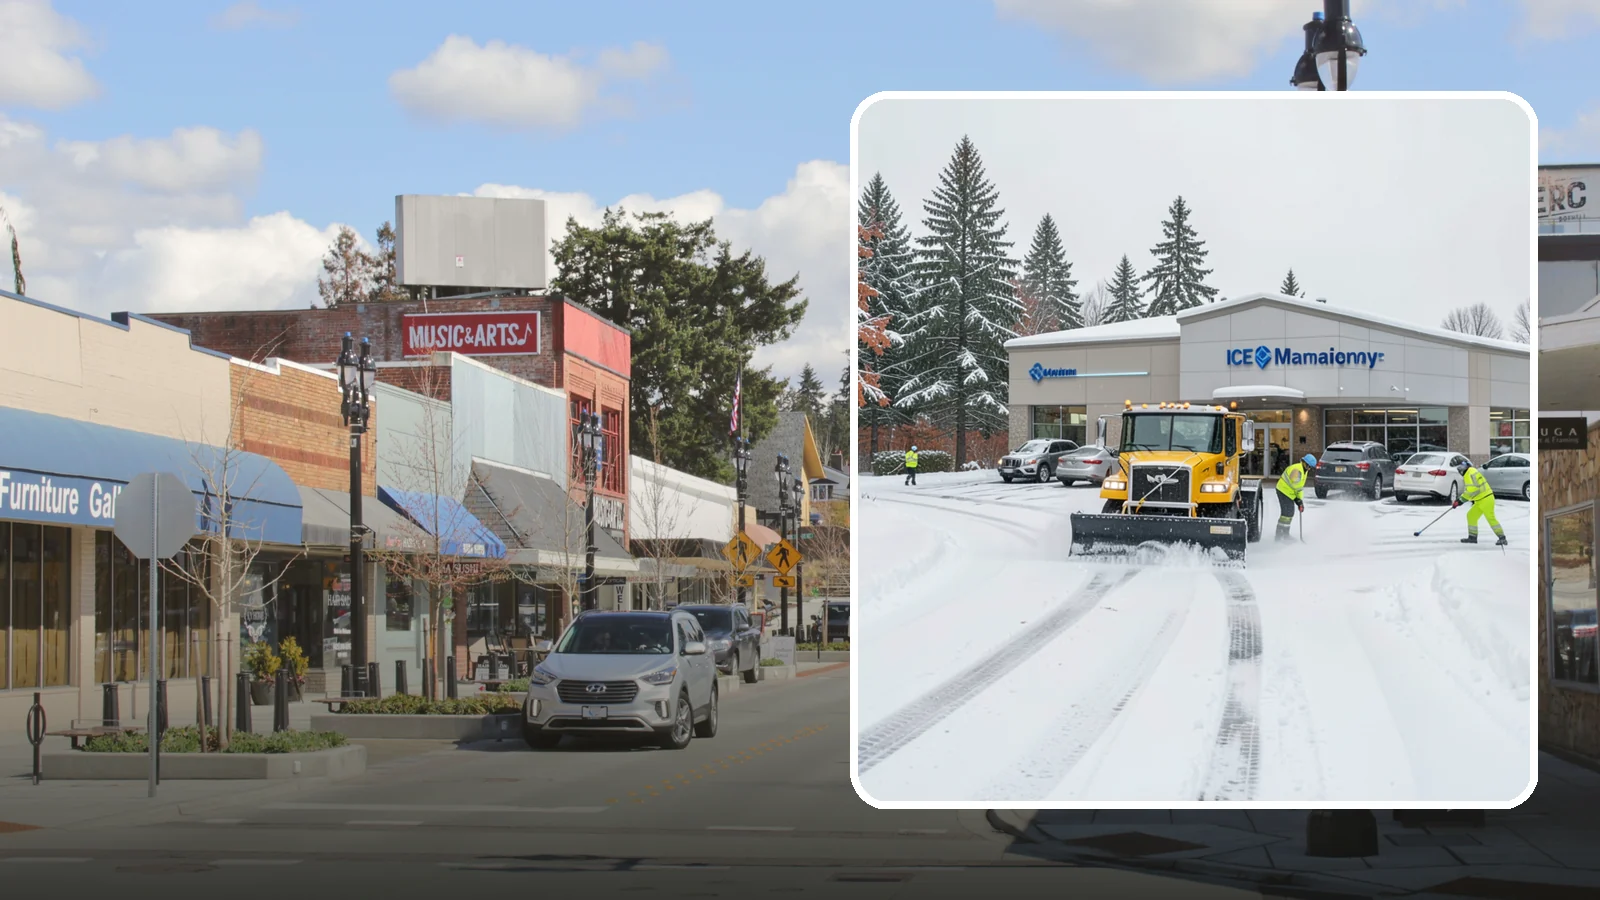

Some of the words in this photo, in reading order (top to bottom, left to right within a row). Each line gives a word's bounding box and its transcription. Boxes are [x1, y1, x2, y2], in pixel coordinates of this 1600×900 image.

[1226, 349, 1254, 366] ICE
[1540, 427, 1577, 437] UGA
[0, 471, 80, 515] Furniture
[89, 482, 122, 519] Gal
